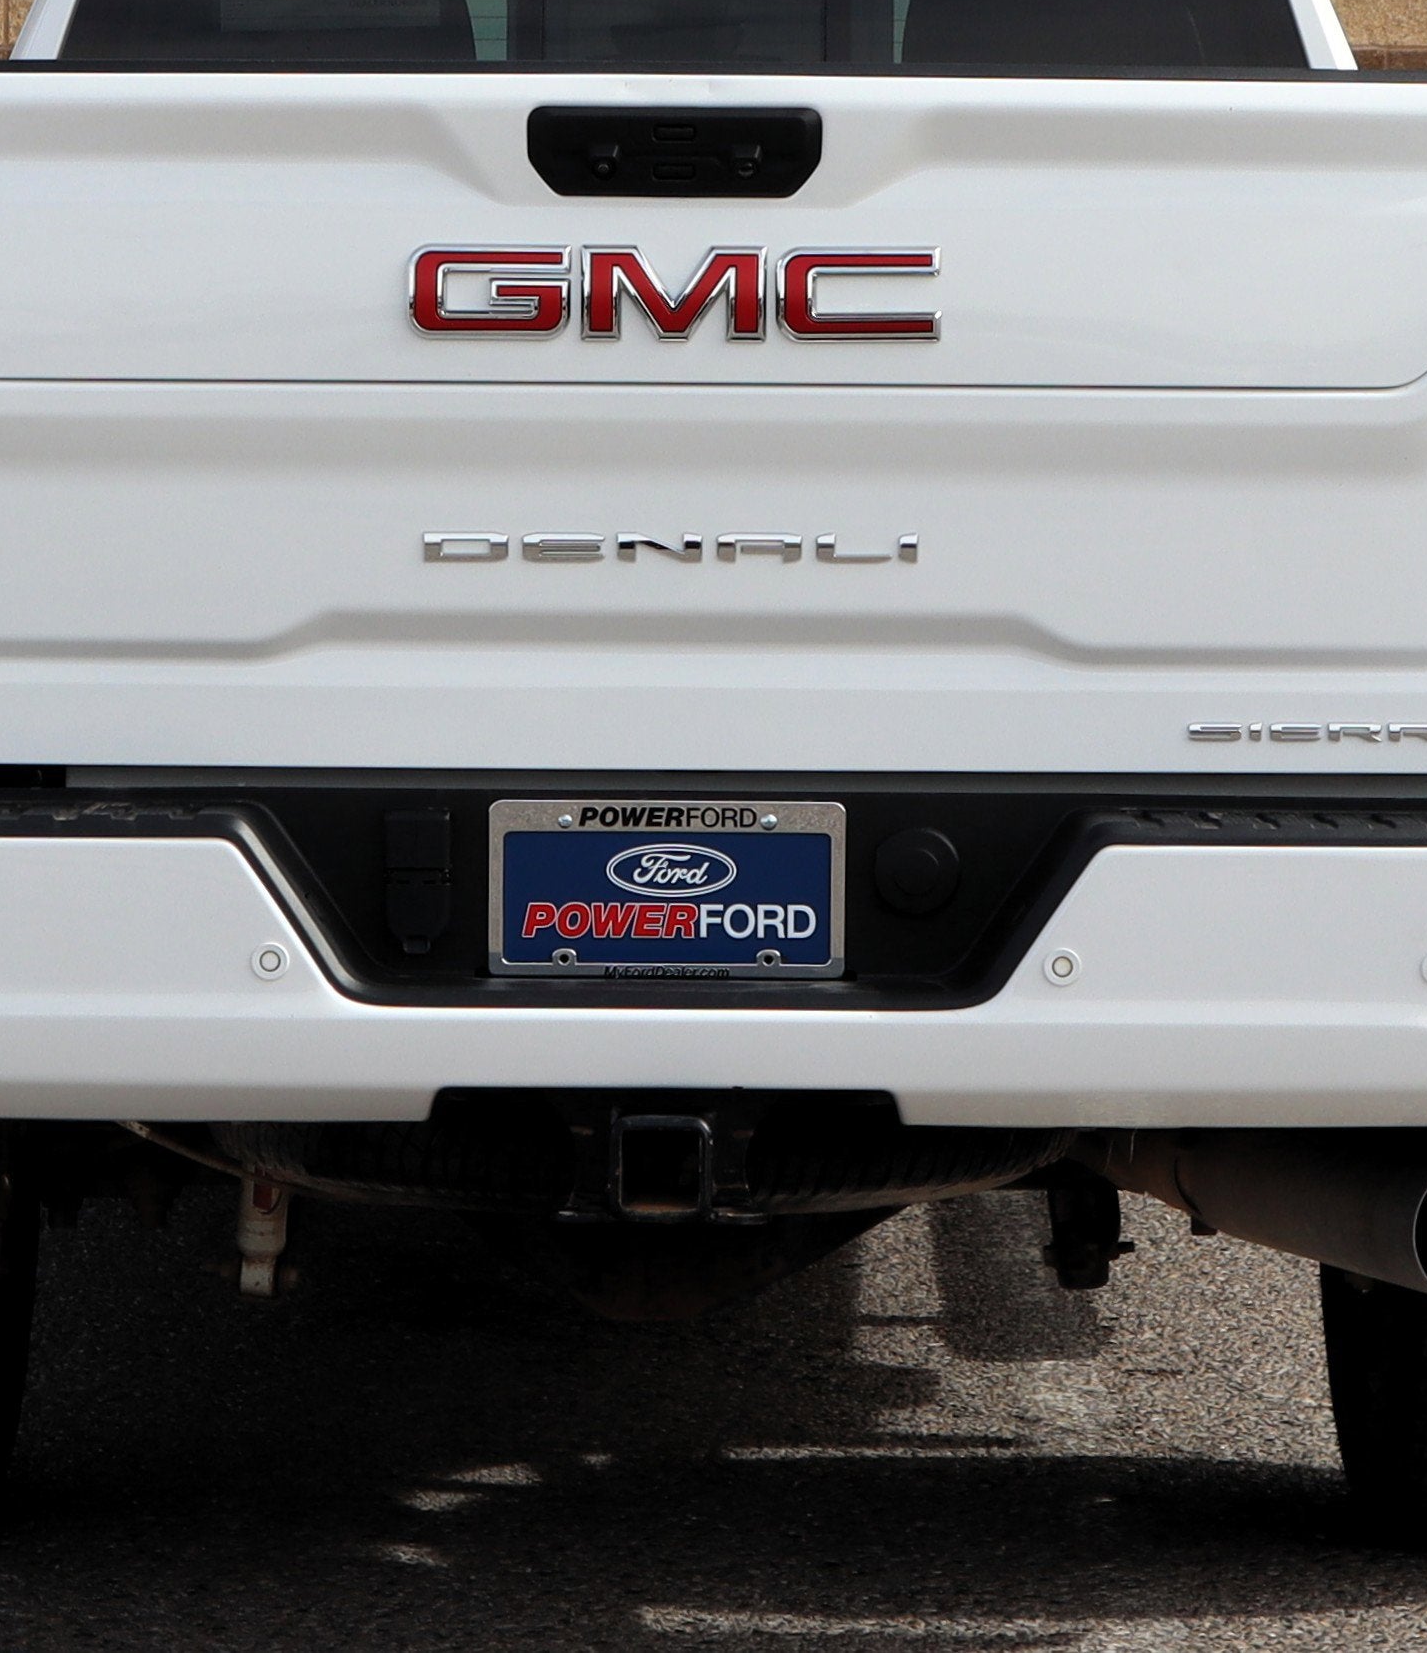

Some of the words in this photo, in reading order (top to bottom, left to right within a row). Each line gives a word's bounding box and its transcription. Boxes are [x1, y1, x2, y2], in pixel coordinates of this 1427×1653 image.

[407, 243, 942, 342] GMC
[422, 531, 920, 564] DENALI
[632, 853, 711, 886] Ford
[603, 965, 730, 980] MyFordDealer.com
